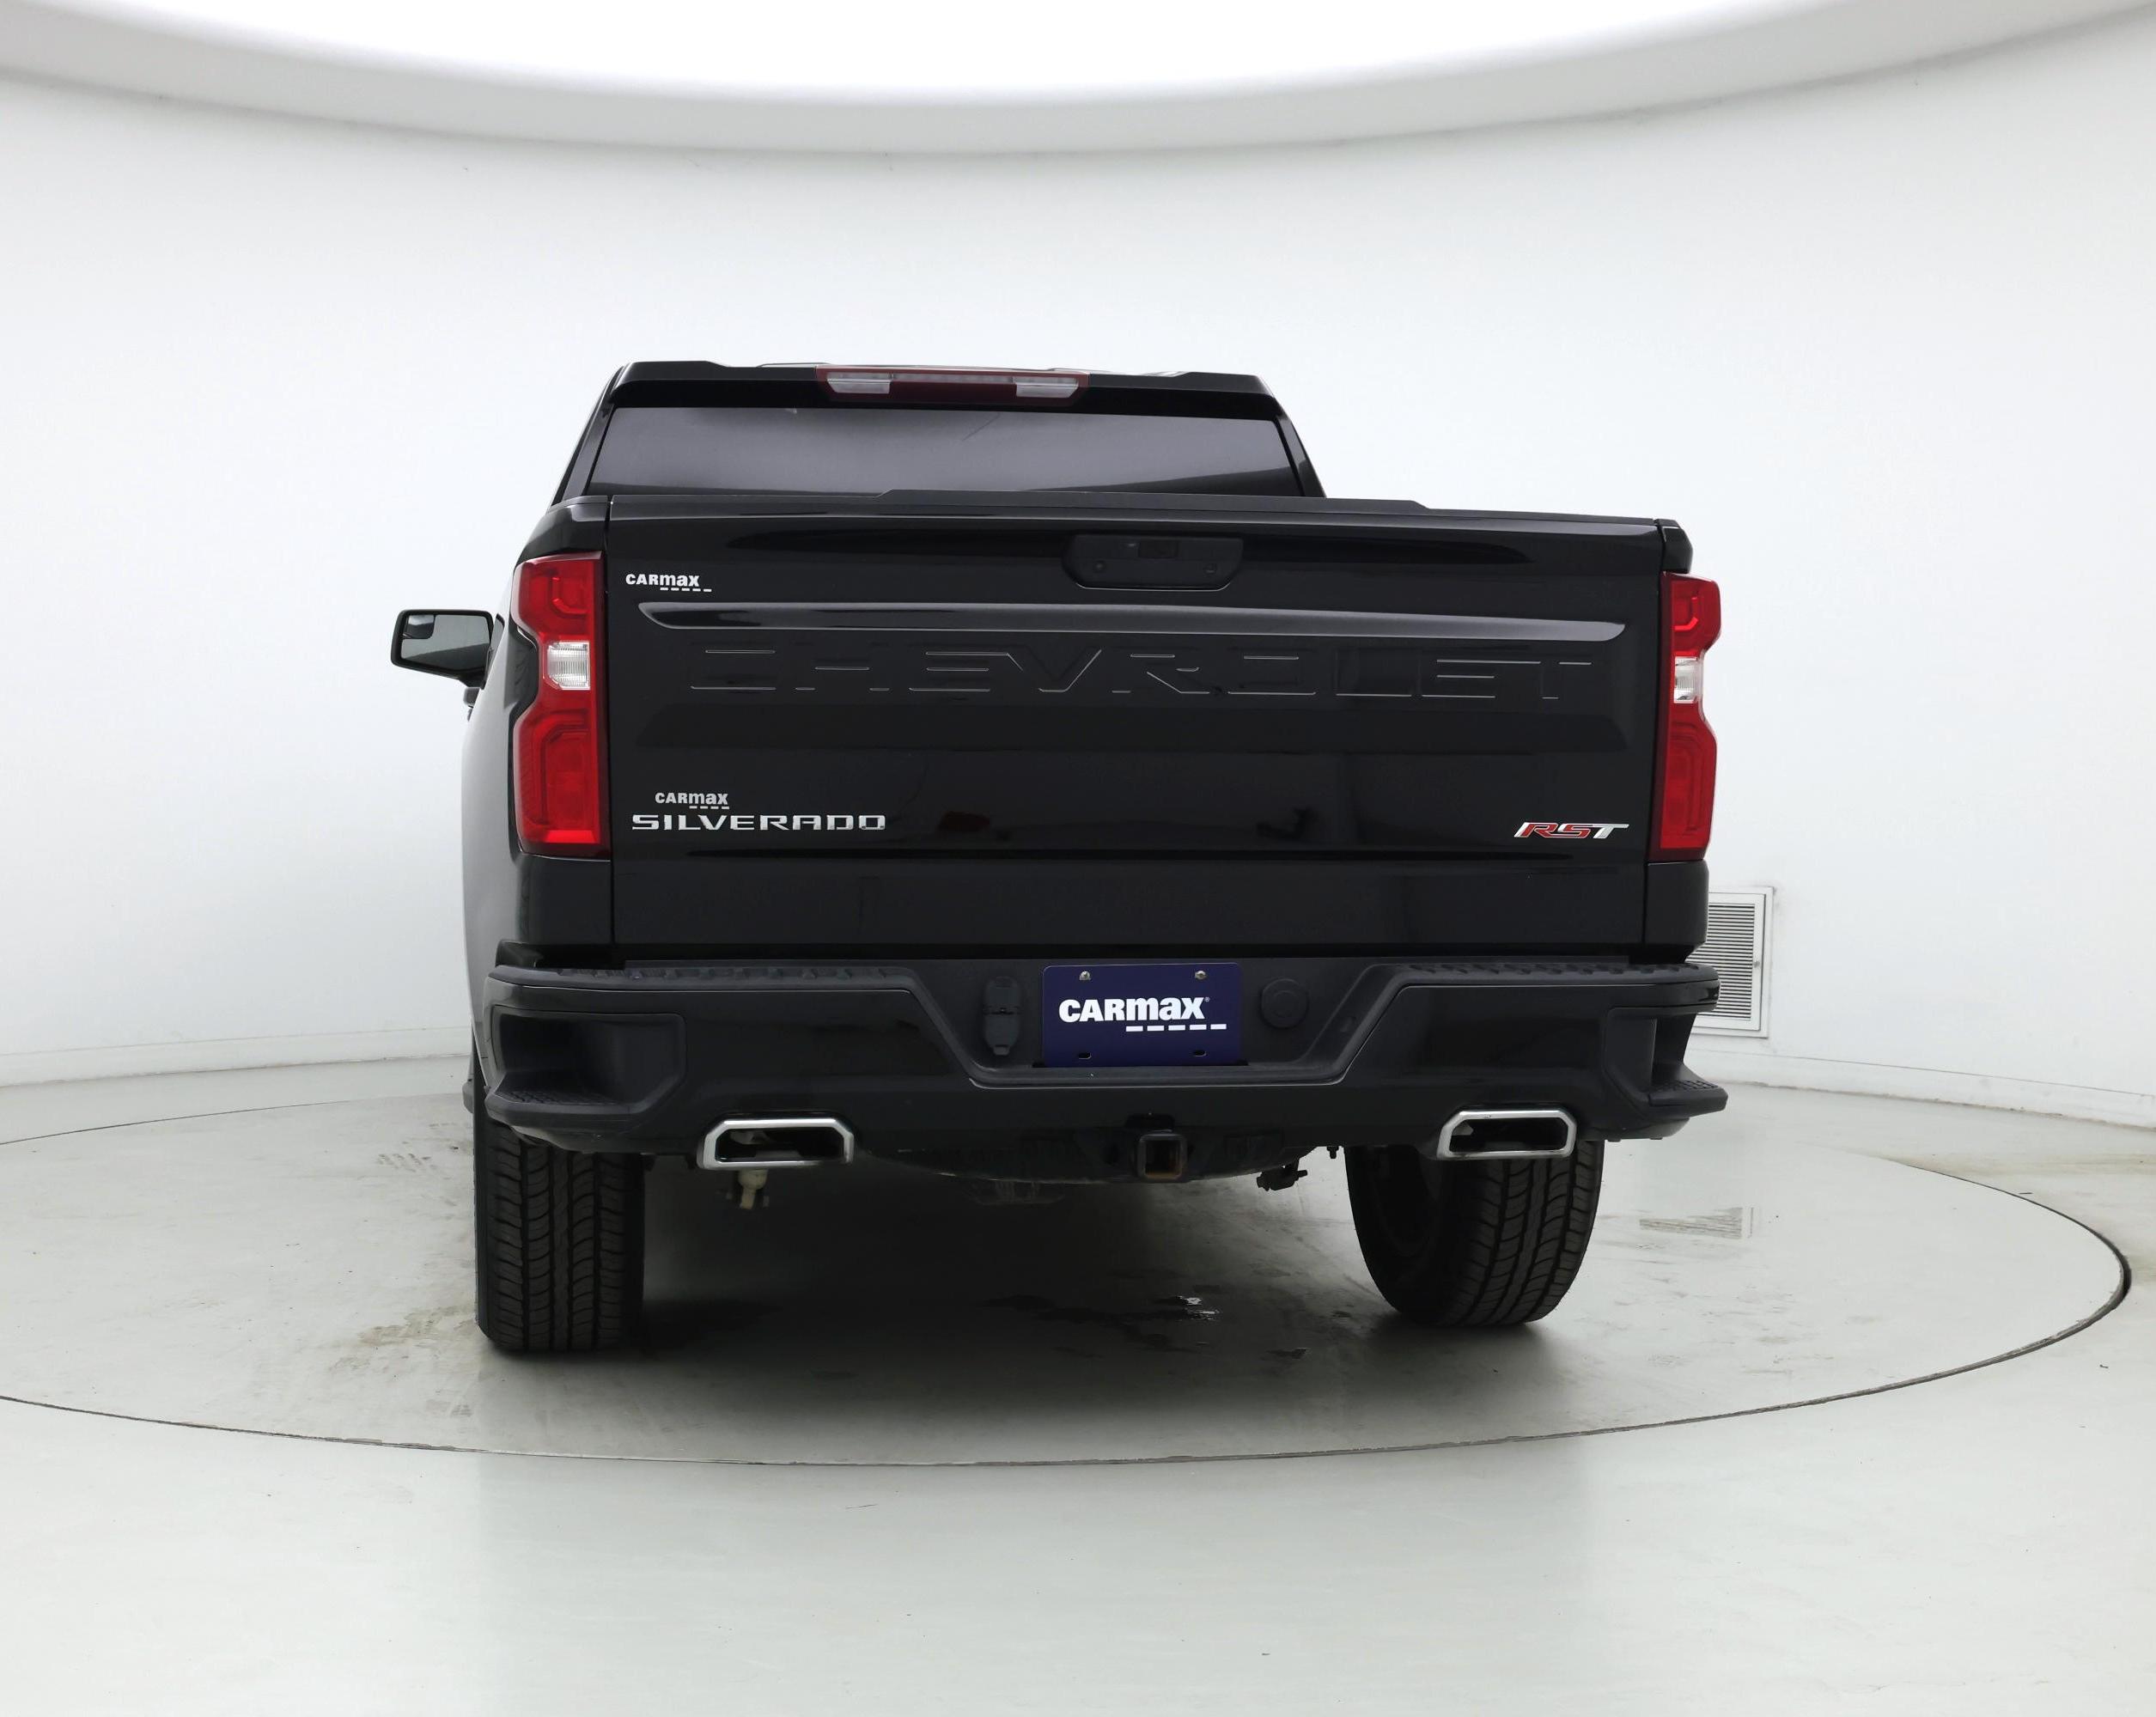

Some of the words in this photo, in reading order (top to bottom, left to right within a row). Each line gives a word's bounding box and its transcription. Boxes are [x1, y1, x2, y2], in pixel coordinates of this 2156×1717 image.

[688, 642, 1593, 700] CHEVROLET
[631, 813, 886, 831] SILVERADO
[1513, 821, 1630, 839] RST
